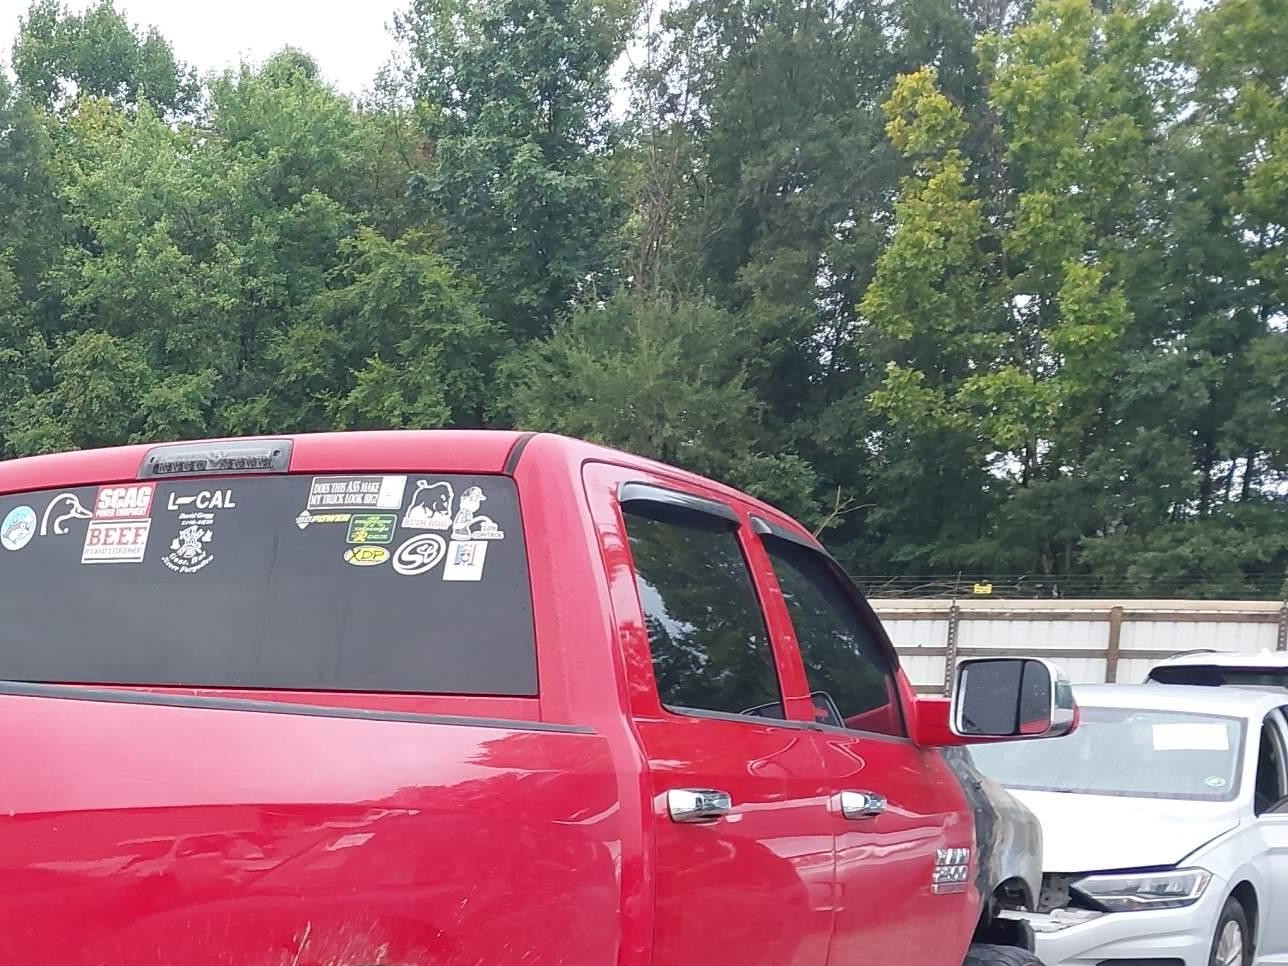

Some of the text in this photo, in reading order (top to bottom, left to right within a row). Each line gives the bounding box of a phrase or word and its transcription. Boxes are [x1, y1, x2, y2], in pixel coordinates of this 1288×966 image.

[331, 483, 346, 493] THIS
[347, 481, 360, 492] ASS
[360, 482, 380, 492] MAKE
[98, 487, 152, 509] SCAG
[322, 494, 345, 504] TRUCK
[345, 494, 363, 504] LOOK
[348, 548, 385, 563] XDP
